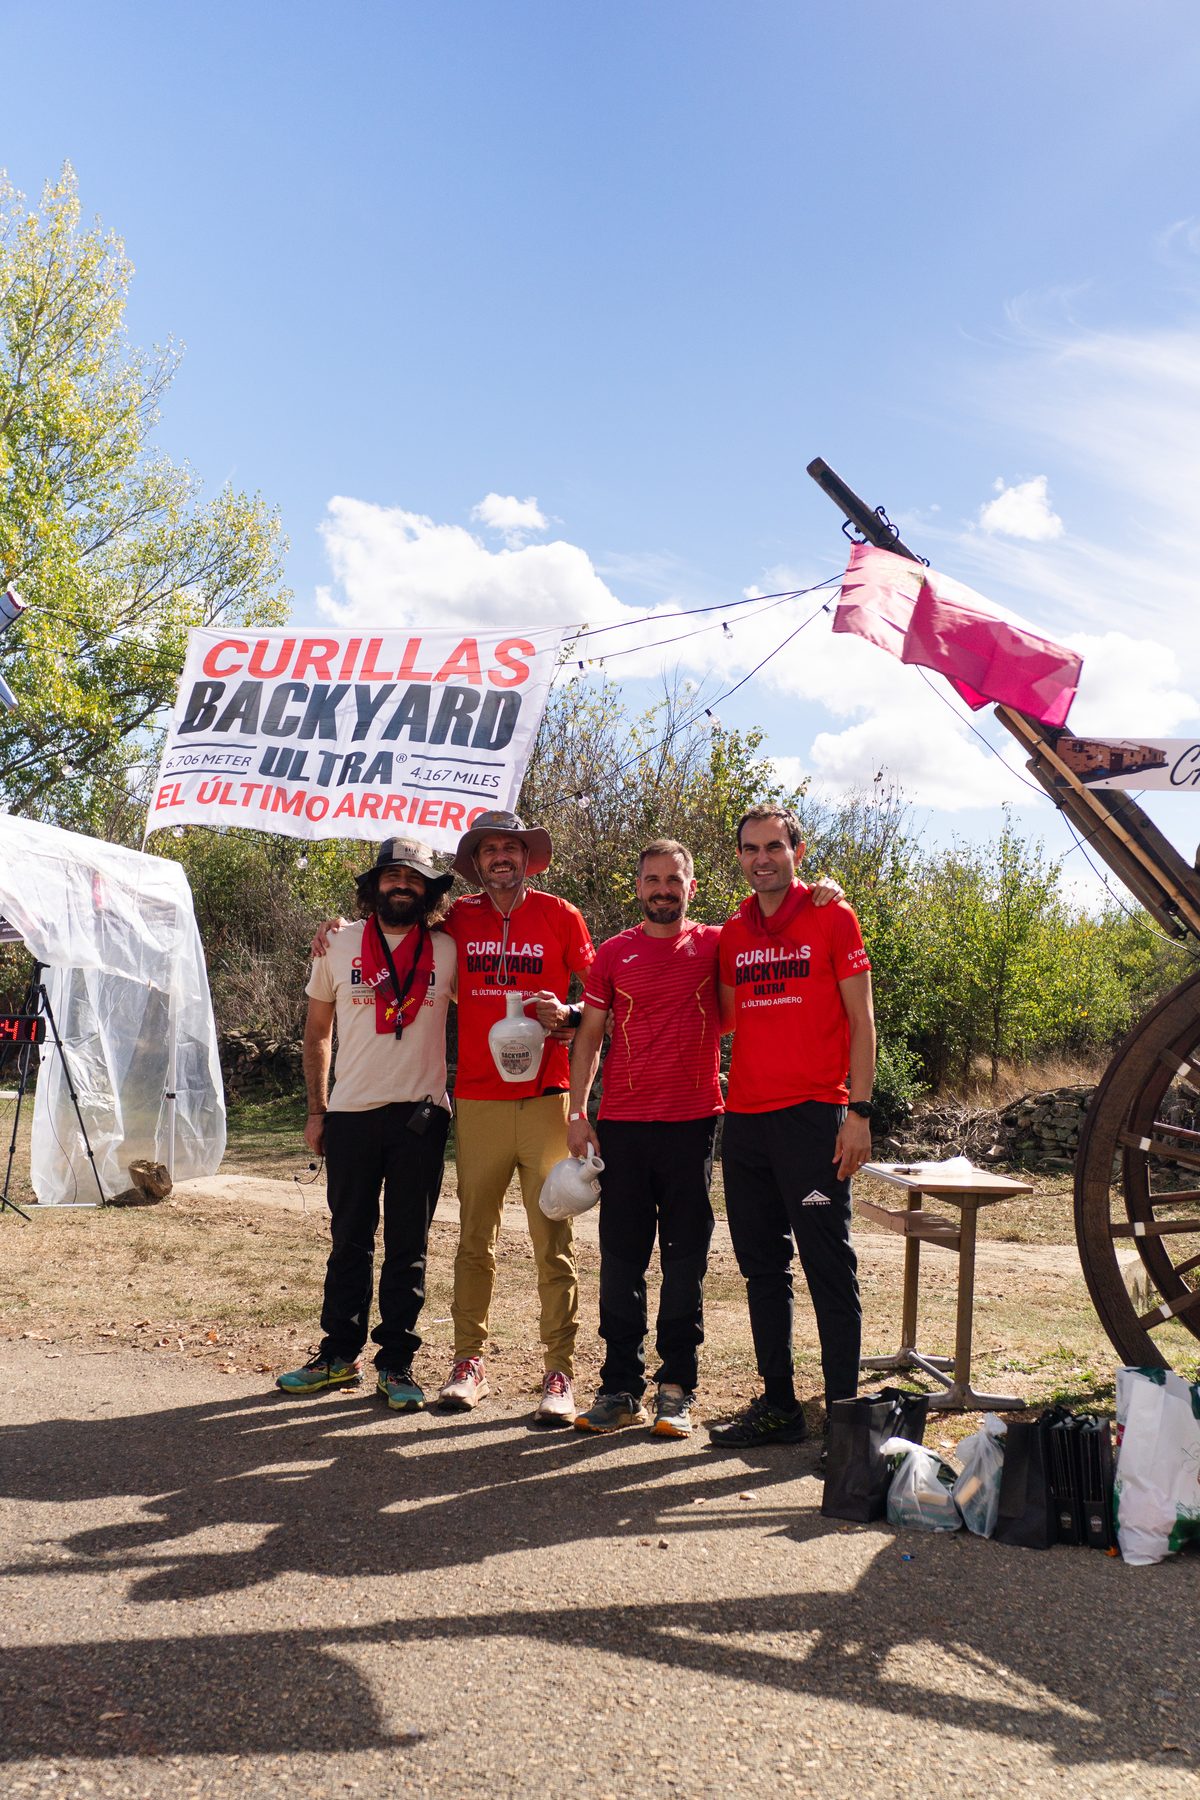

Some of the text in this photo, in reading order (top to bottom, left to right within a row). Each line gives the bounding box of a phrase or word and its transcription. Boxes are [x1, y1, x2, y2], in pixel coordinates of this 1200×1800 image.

[202, 638, 536, 688] CURILLAS
[177, 680, 523, 751] BACKYARD
[166, 754, 252, 769] 6.706 METER
[410, 767, 501, 788] 4.167 MILES
[155, 782, 186, 811] EL
[196, 775, 330, 823] ÚLTIMO
[466, 941, 544, 957] CURILLAS
[466, 954, 543, 975] BACKYARD
[735, 959, 810, 986] BACKYARD
[479, 987, 502, 996] ÚLTIMO
[753, 982, 785, 995] ULTRA
[747, 999, 772, 1008] ÚLTIMO
[773, 996, 803, 1005] ARRIERO
